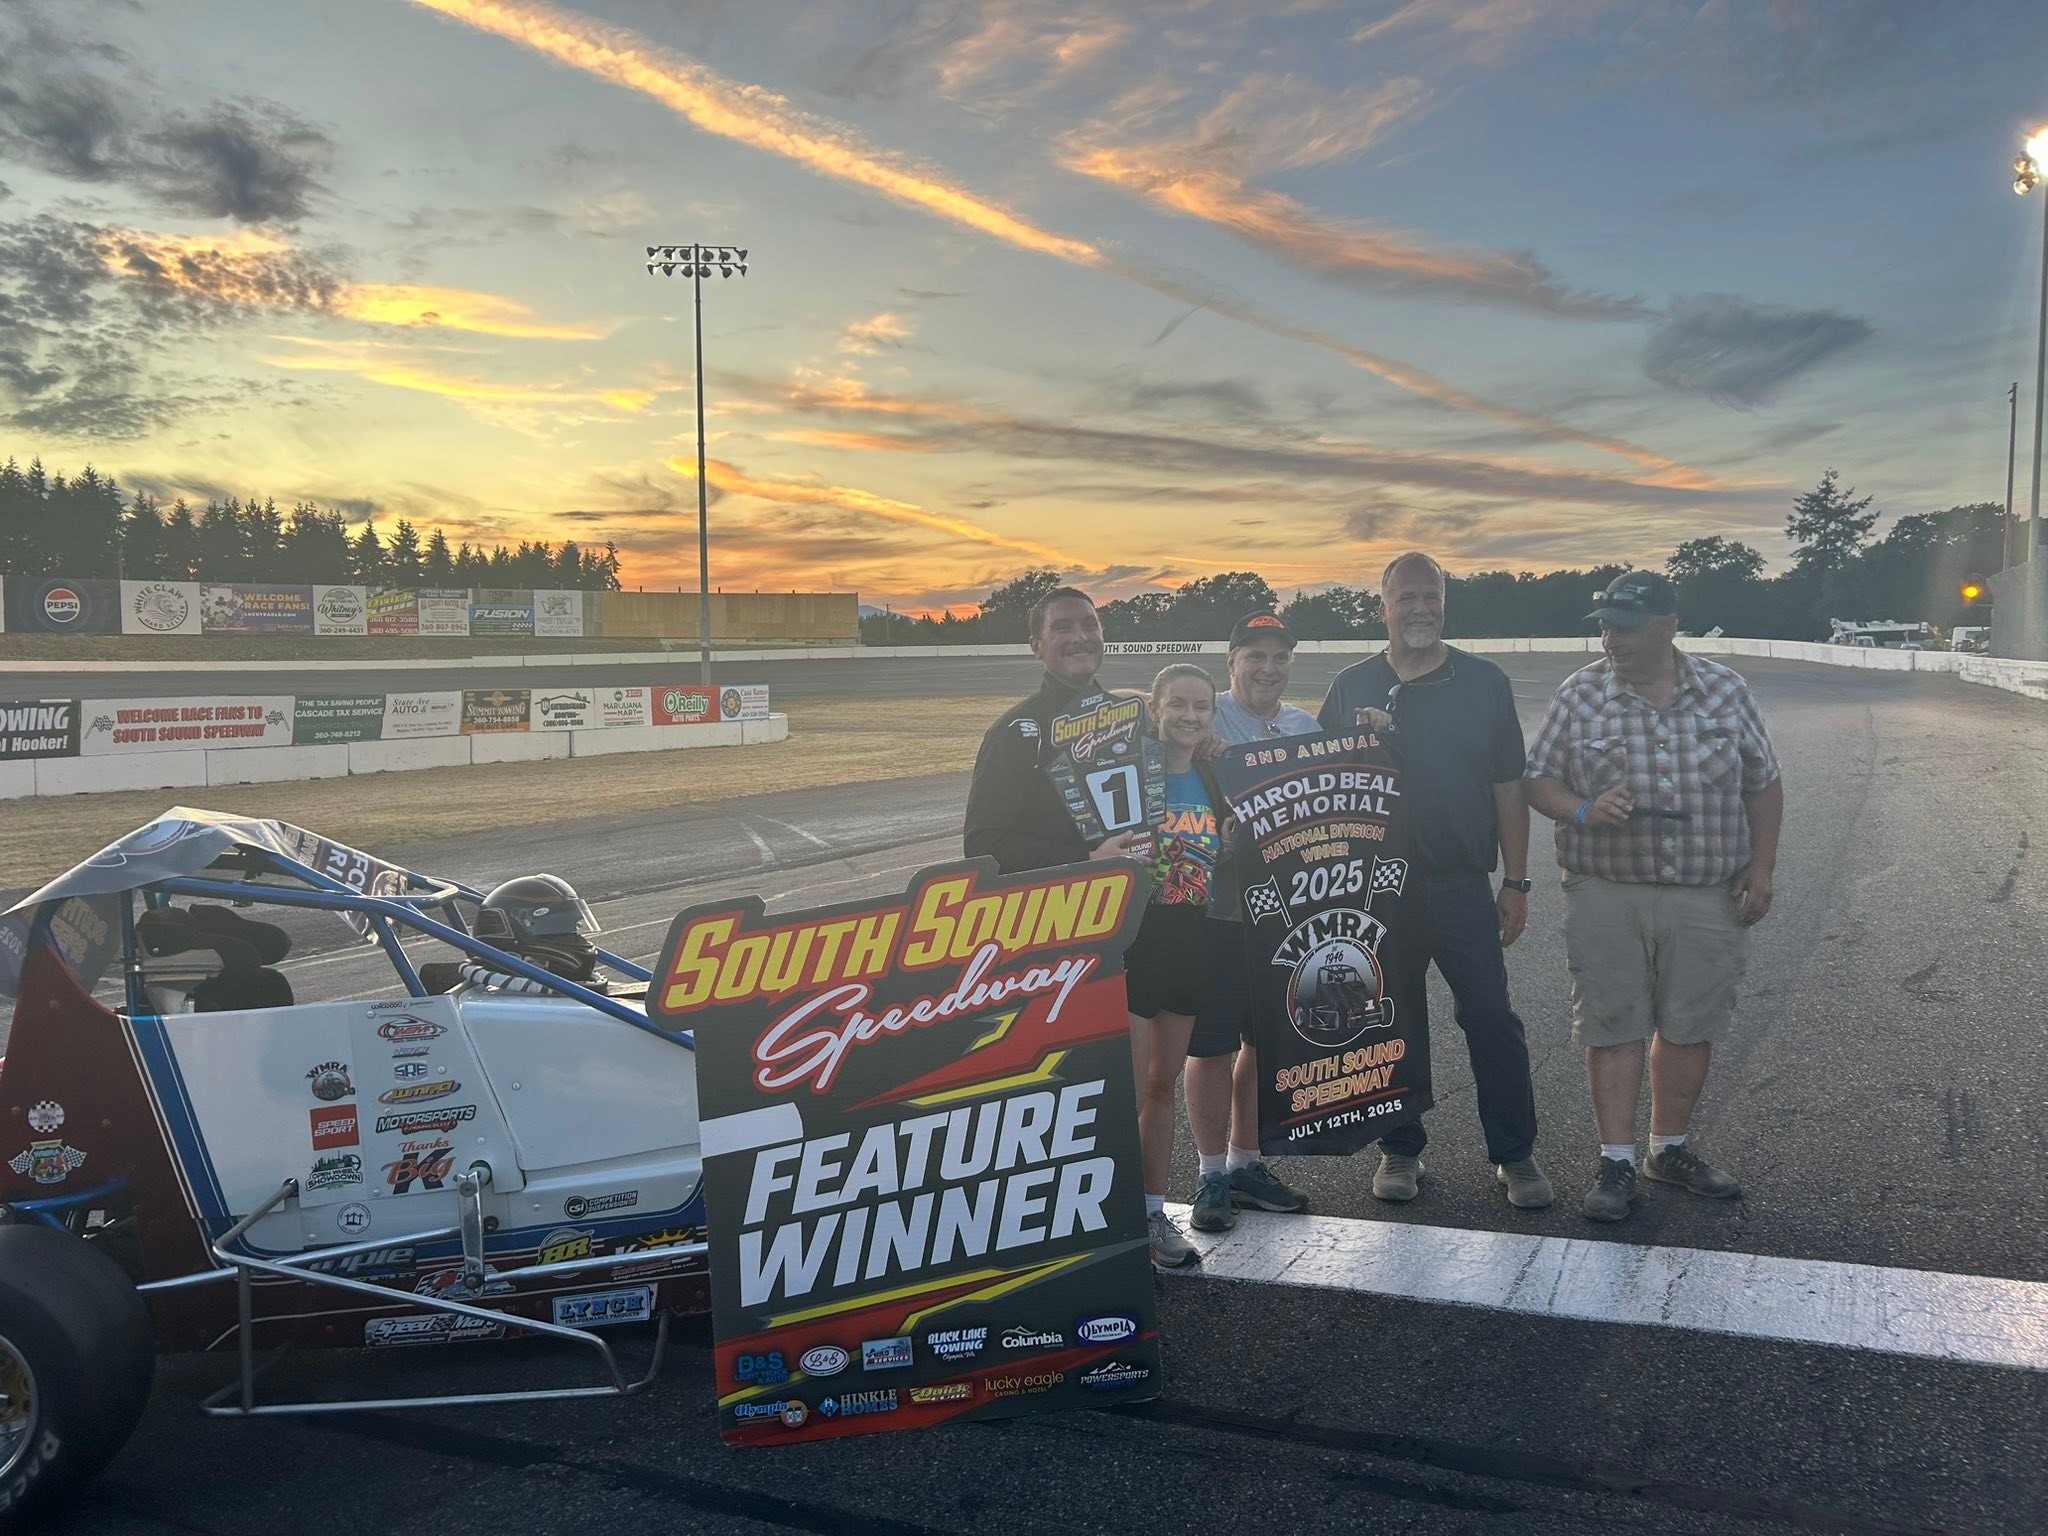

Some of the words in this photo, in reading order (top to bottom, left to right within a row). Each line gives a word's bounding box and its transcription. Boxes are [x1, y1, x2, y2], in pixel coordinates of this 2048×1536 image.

[46, 602, 78, 610] PEPSI
[135, 586, 153, 614] WHITE
[154, 584, 184, 599] CLAW
[244, 594, 302, 602] WELCOME
[278, 602, 310, 610] FANS!
[144, 618, 164, 629] HARD
[166, 605, 185, 629] SELTZER
[317, 602, 363, 614] Whitney's
[474, 610, 530, 618] FUSION
[1123, 644, 1153, 653] SOUND
[1156, 643, 1203, 653] SPEEDWAY
[392, 706, 419, 714] AUTO
[467, 703, 496, 717] SUMMIT
[498, 702, 526, 716] TOWING
[603, 702, 643, 711] MARIJUANA
[665, 691, 709, 714] O'Reilly
[1080, 694, 1105, 708] 2025
[116, 708, 180, 724] WELCOME
[181, 707, 213, 723] RACE
[215, 707, 246, 721] FANS
[248, 706, 263, 720] TO
[295, 710, 334, 718] CASCADE
[336, 709, 350, 717] TAX
[352, 708, 384, 716] SERVICE
[617, 709, 637, 717] MART
[685, 714, 701, 722] PARTS
[1055, 719, 1097, 743] SOUTH
[1098, 702, 1139, 729] SOUND
[113, 728, 157, 744] SOUTH
[158, 727, 202, 742] SOUND
[203, 724, 266, 740] SPEEDWAY
[1075, 720, 1136, 758] Speedway
[12, 735, 68, 752] Hooker!
[1246, 749, 1287, 767] 2ND
[1297, 733, 1380, 760] ANNUAL
[1234, 775, 1336, 824] HAROLD
[1340, 771, 1402, 797] BEAL
[1253, 795, 1391, 840] MEMORIAL
[1262, 826, 1329, 864] NATIONAL
[1330, 823, 1385, 842] DIVISION
[1301, 841, 1350, 863] WINNER
[1290, 860, 1365, 906] 2025
[665, 912, 901, 1009] SOUTH
[904, 874, 1129, 967] SOUND
[1275, 912, 1380, 964] WMRA
[1325, 954, 1344, 965] 1946
[755, 943, 1096, 1090] Speedway
[305, 1062, 347, 1079] WMRA
[1275, 1055, 1339, 1092] SOUTH
[1341, 1039, 1405, 1076] SOUND
[1292, 1065, 1395, 1112] SPEEDWAY
[318, 1118, 356, 1129] SPEED
[378, 1106, 475, 1132] MOTORSPORTS
[1288, 1122, 1322, 1142] JULY
[1325, 1112, 1365, 1133] 12TH,
[1367, 1100, 1403, 1118] 2025
[314, 1125, 355, 1137] SPORT
[398, 1137, 449, 1153] Thanks
[744, 1079, 1106, 1225] FEATURE
[381, 1156, 457, 1185] Big
[308, 1174, 360, 1188] SHOWDOWN
[569, 1202, 585, 1213] CSI
[589, 1192, 637, 1206] COMPETITION
[740, 1156, 1115, 1308] WINNER
[543, 1236, 591, 1265] BR
[560, 1295, 644, 1320] LYNCH
[374, 1317, 438, 1337] Speed
[928, 1331, 959, 1344] BLACK
[962, 1327, 987, 1340] LAKE
[1082, 1320, 1132, 1339] OLYMPIA
[933, 1340, 984, 1355] TOWING
[1002, 1332, 1064, 1349] Columbia
[738, 1352, 783, 1374] D&S
[874, 1356, 909, 1364] SERVICES
[985, 1376, 1022, 1391] lucky
[1025, 1371, 1064, 1388] eagle
[1080, 1370, 1149, 1384] POWERSPORTS
[840, 1389, 898, 1404] HINKLE
[995, 1390, 1020, 1398] CASINO
[735, 1400, 788, 1417] Olympia
[841, 1400, 898, 1416] HOMES
